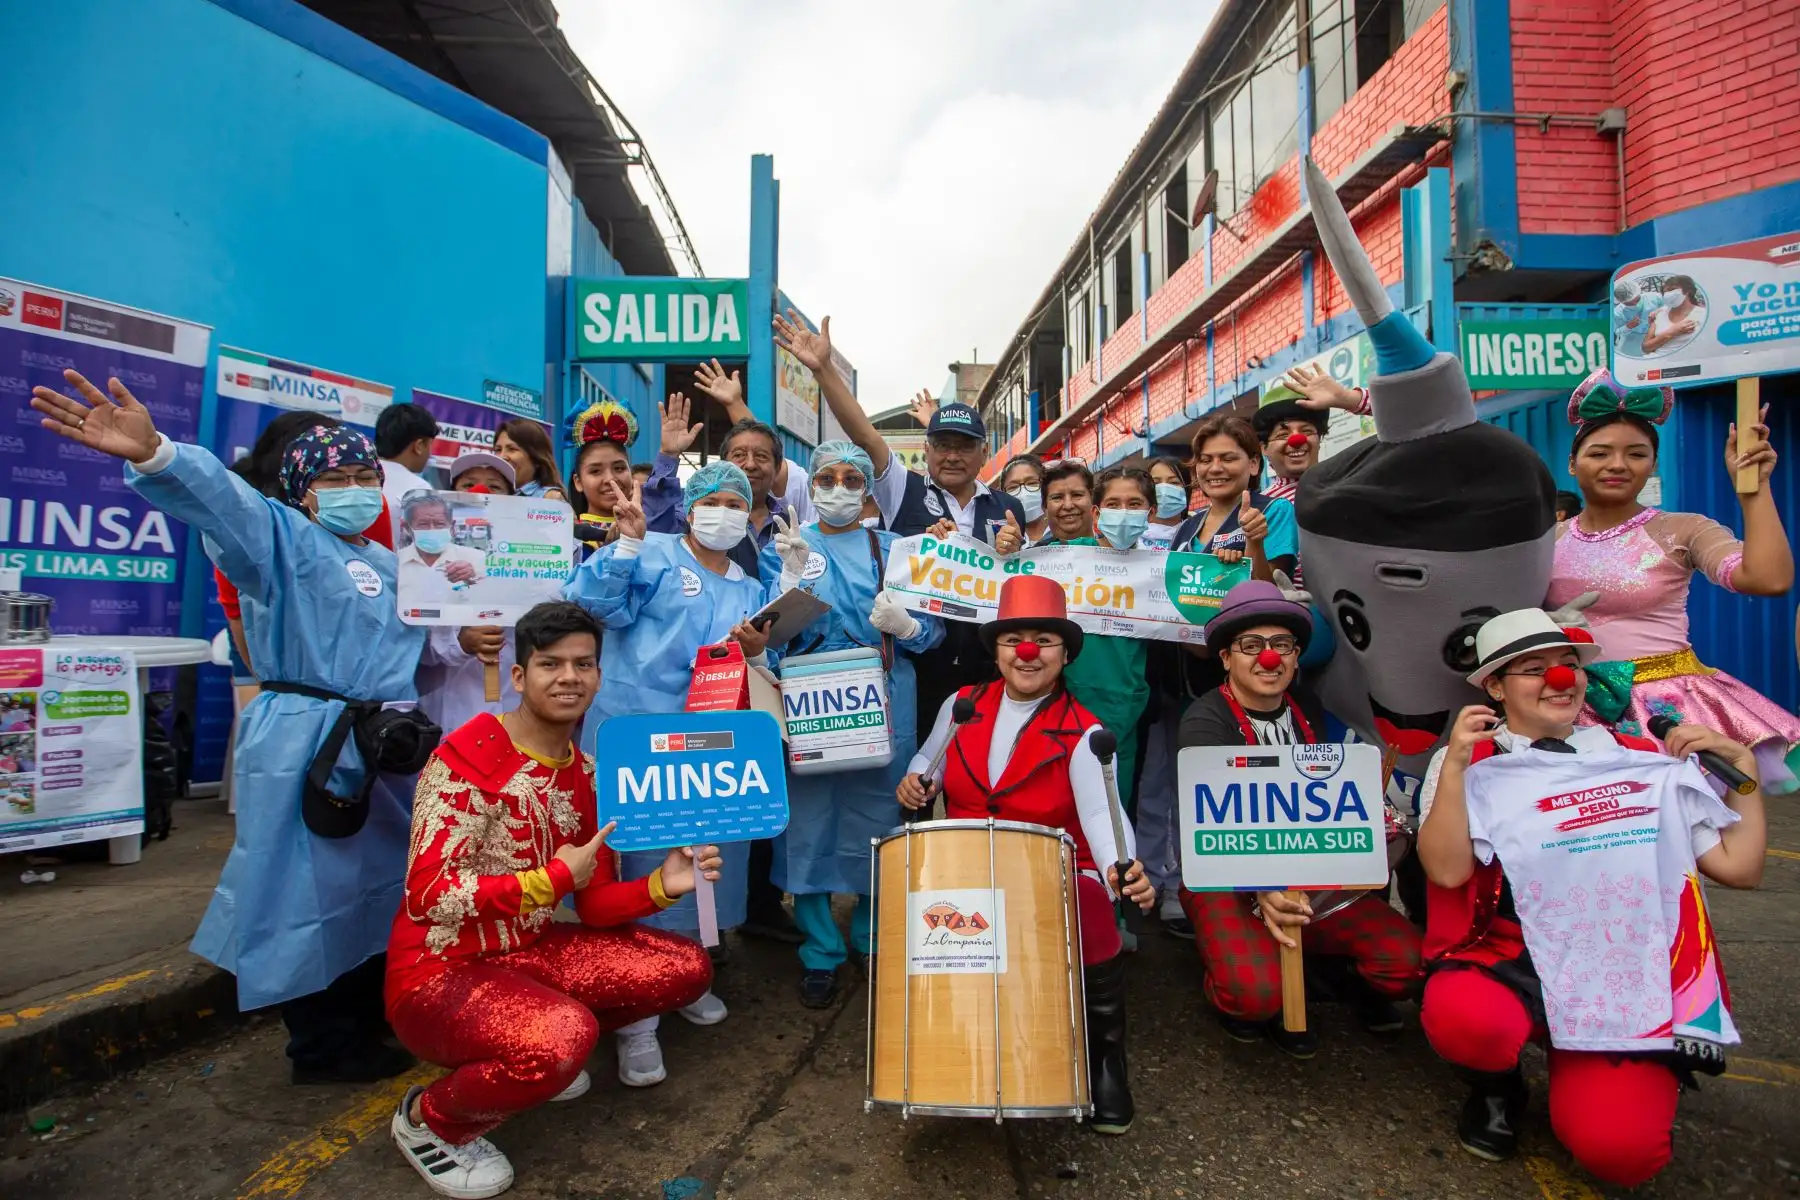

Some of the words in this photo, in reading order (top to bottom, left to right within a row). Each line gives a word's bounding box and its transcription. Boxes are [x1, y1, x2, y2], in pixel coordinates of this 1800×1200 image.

[1732, 281, 1777, 301] Yo
[583, 292, 741, 343] SALIDA
[1741, 318, 1777, 333] para
[1747, 326, 1780, 339] más
[1468, 332, 1607, 376] INGRESO
[269, 374, 341, 404] MINSA
[494, 385, 534, 402] ATENCIÓN
[486, 391, 540, 412] PREFERENCIAL
[940, 410, 972, 420] MINSA
[438, 426, 459, 439] ME
[517, 559, 569, 569] vacunas
[920, 537, 995, 571] Punto
[1003, 559, 1036, 575] de
[35, 554, 109, 577] LIMA
[116, 559, 169, 580] SUR
[486, 567, 528, 579] salvan
[533, 568, 569, 580] vidas!
[1095, 565, 1128, 574] MINSA
[1180, 565, 1206, 587] Sí,
[1180, 586, 1198, 594] me
[706, 671, 741, 682] DESLAB
[111, 694, 126, 703] de
[783, 684, 882, 718] MINSA
[788, 720, 820, 734] DIRIS
[823, 716, 855, 730] LIMA
[857, 713, 883, 726] SUR
[1304, 744, 1333, 753] DIRIS
[1296, 754, 1319, 762] LIMA
[1321, 754, 1340, 762] SUR
[617, 759, 770, 804] MINSA
[1194, 780, 1369, 824] MINSA
[1551, 797, 1573, 808] ME
[1573, 784, 1631, 803] VACUNO
[1578, 796, 1620, 817] PERÚ
[1564, 819, 1592, 830] COMPLETA
[1201, 833, 1259, 852] DIRIS
[1265, 833, 1319, 851] LIMA
[1324, 831, 1368, 849] SUR
[1541, 841, 1555, 850] Las
[1556, 836, 1591, 847] vacunas
[1592, 832, 1620, 842] contra
[1568, 843, 1602, 854] seguras
[1610, 838, 1637, 848] salvan
